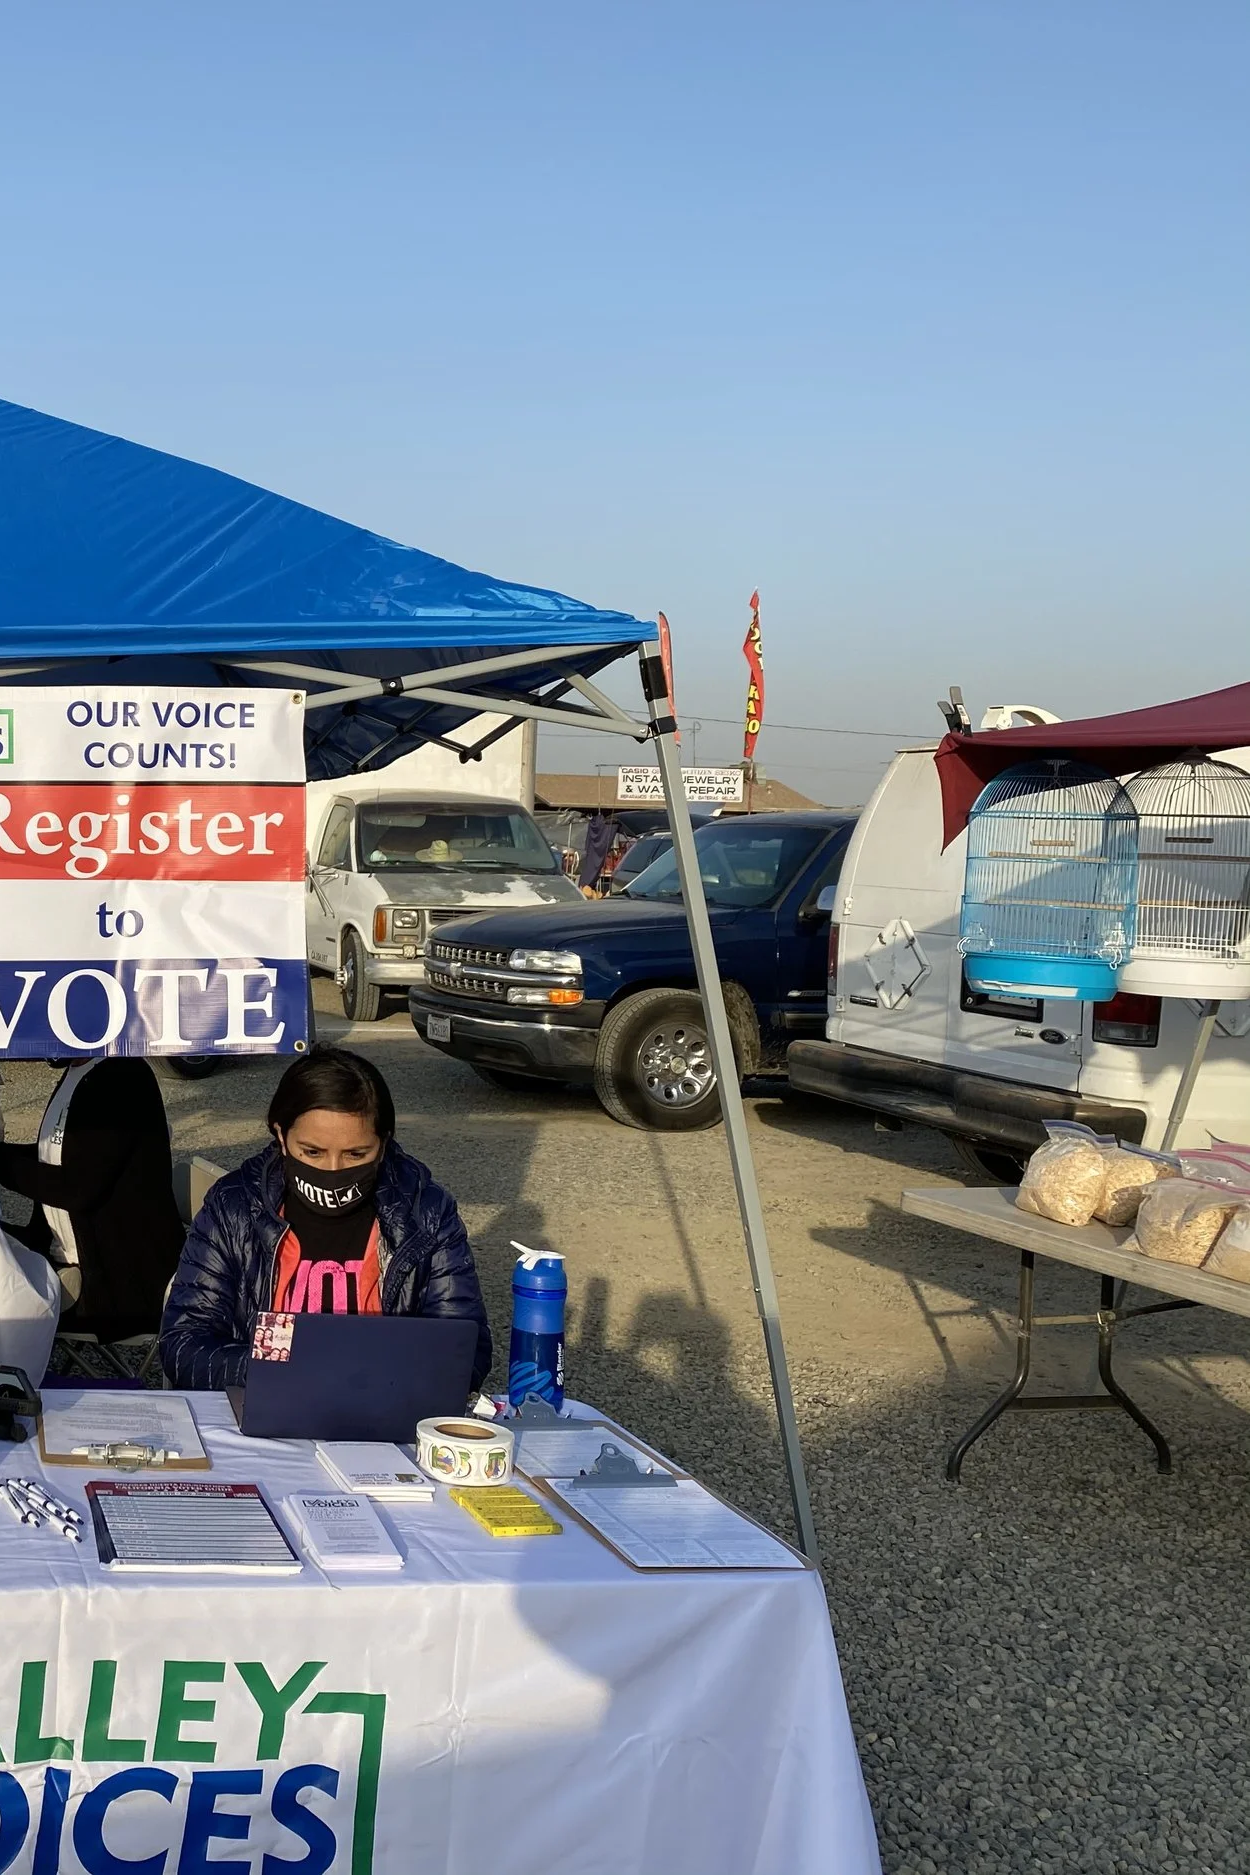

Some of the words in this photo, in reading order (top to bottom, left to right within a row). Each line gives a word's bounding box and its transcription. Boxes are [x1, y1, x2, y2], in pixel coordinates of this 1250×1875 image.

[66, 701, 140, 728] OUR
[152, 702, 255, 729] VOICE
[84, 742, 236, 769] COUNTS!
[623, 775, 662, 783] INSTA
[683, 776, 739, 785] JEWELRY
[625, 785, 633, 793] &
[638, 785, 664, 793] WA
[689, 786, 736, 795] REPAIR
[95, 902, 144, 938] to
[295, 1176, 337, 1208] VOTE
